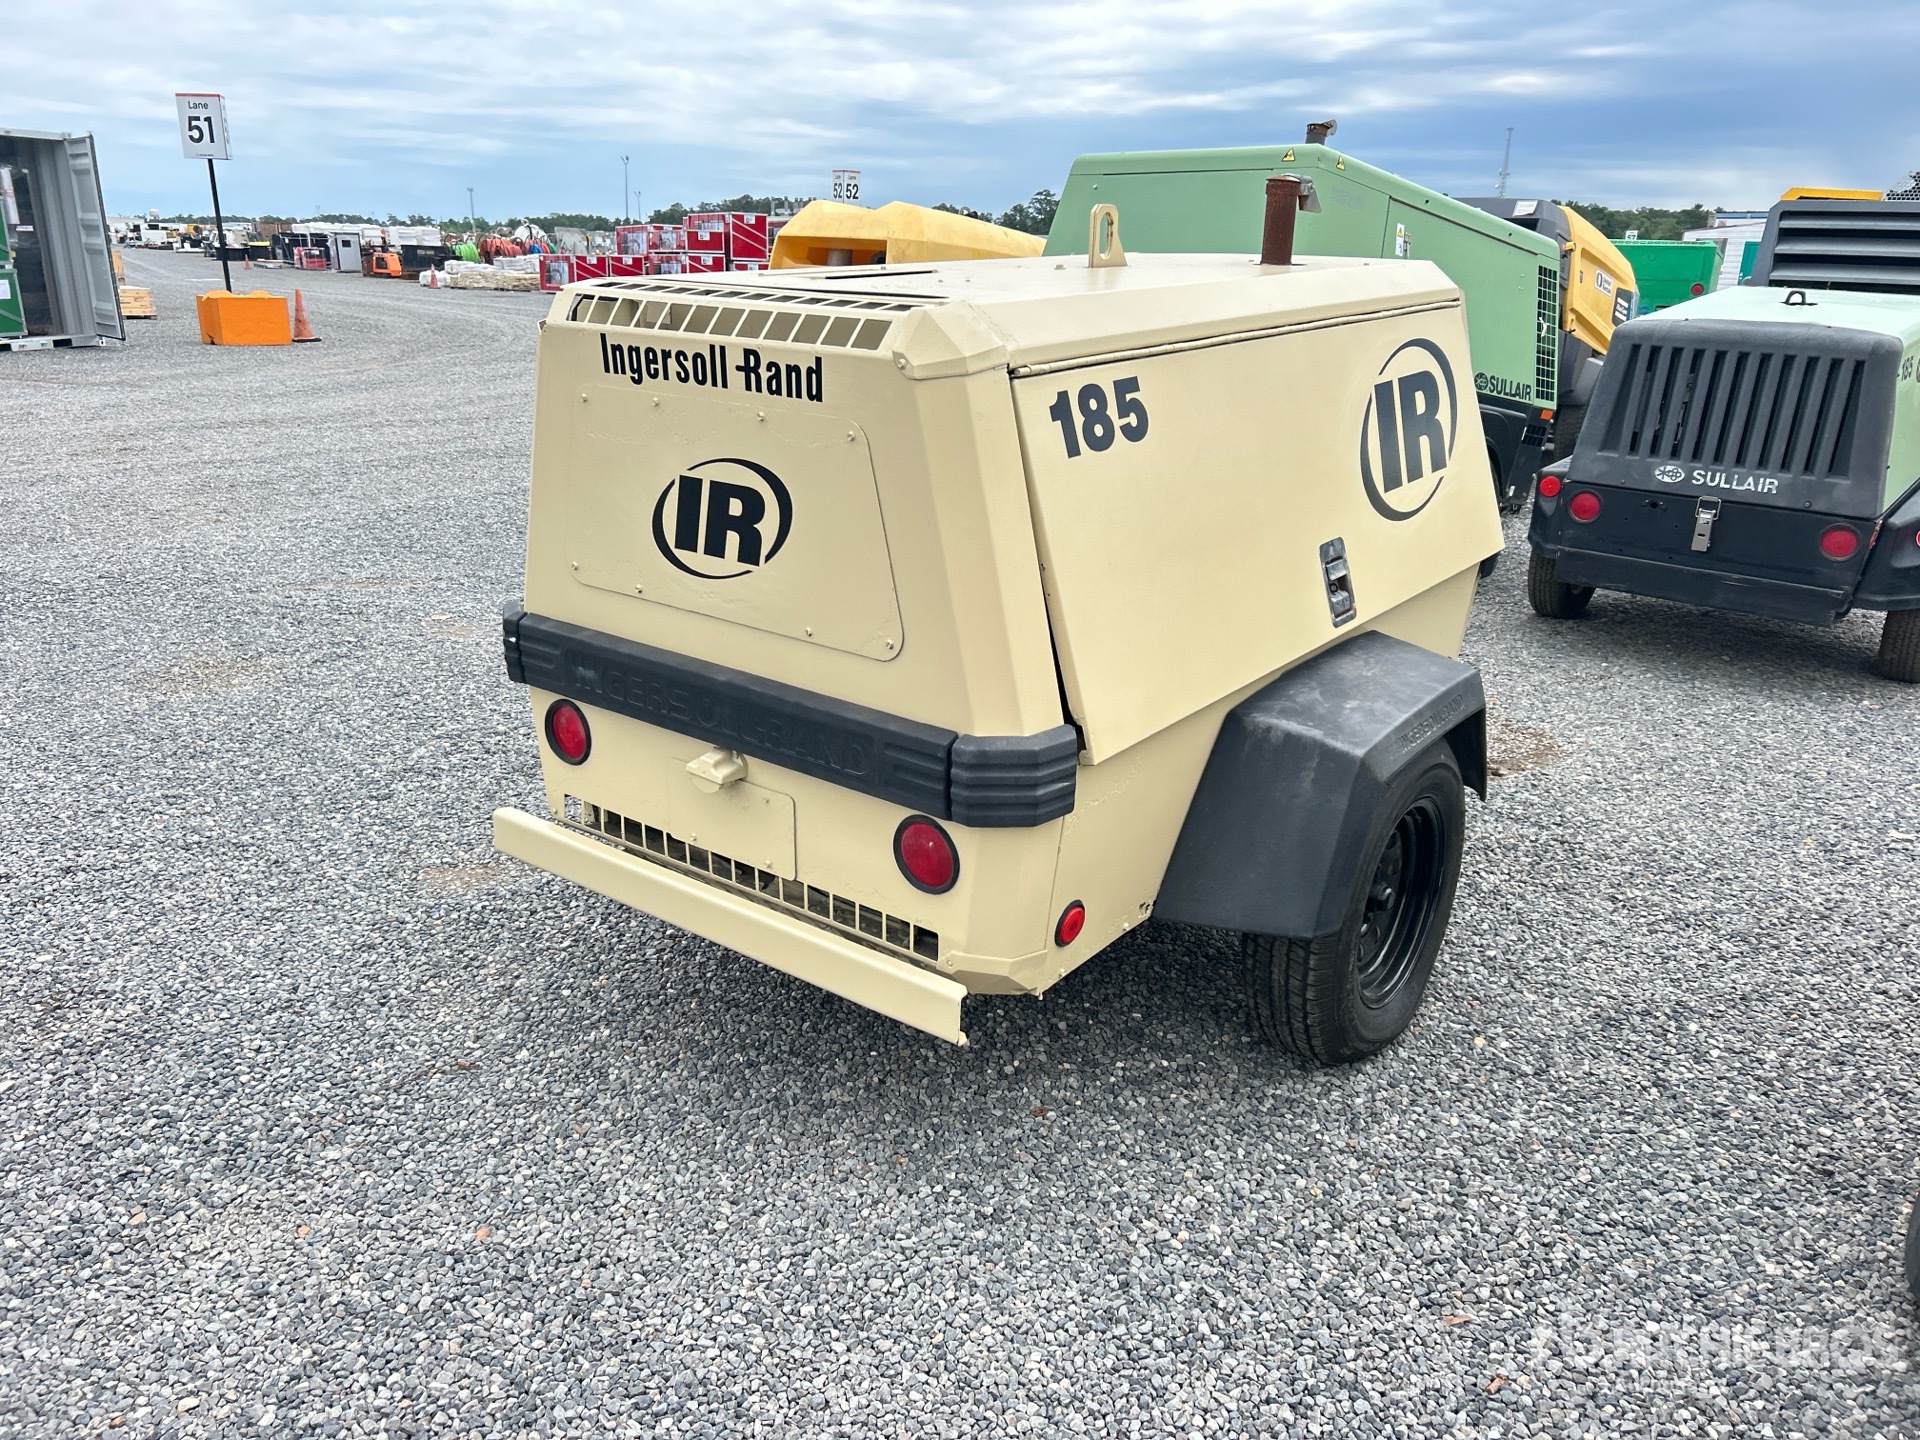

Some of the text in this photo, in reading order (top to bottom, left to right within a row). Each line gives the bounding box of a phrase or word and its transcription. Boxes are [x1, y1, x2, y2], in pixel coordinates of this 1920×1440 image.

[187, 100, 209, 110] Lane
[187, 115, 215, 144] 51
[833, 182, 842, 199] 52
[845, 183, 859, 200] 52
[1488, 374, 1532, 402] SULLAIR
[1048, 375, 1149, 459] 185
[1373, 369, 1448, 494] IR
[1691, 469, 1779, 494] SULLAIR
[674, 474, 766, 567] IR
